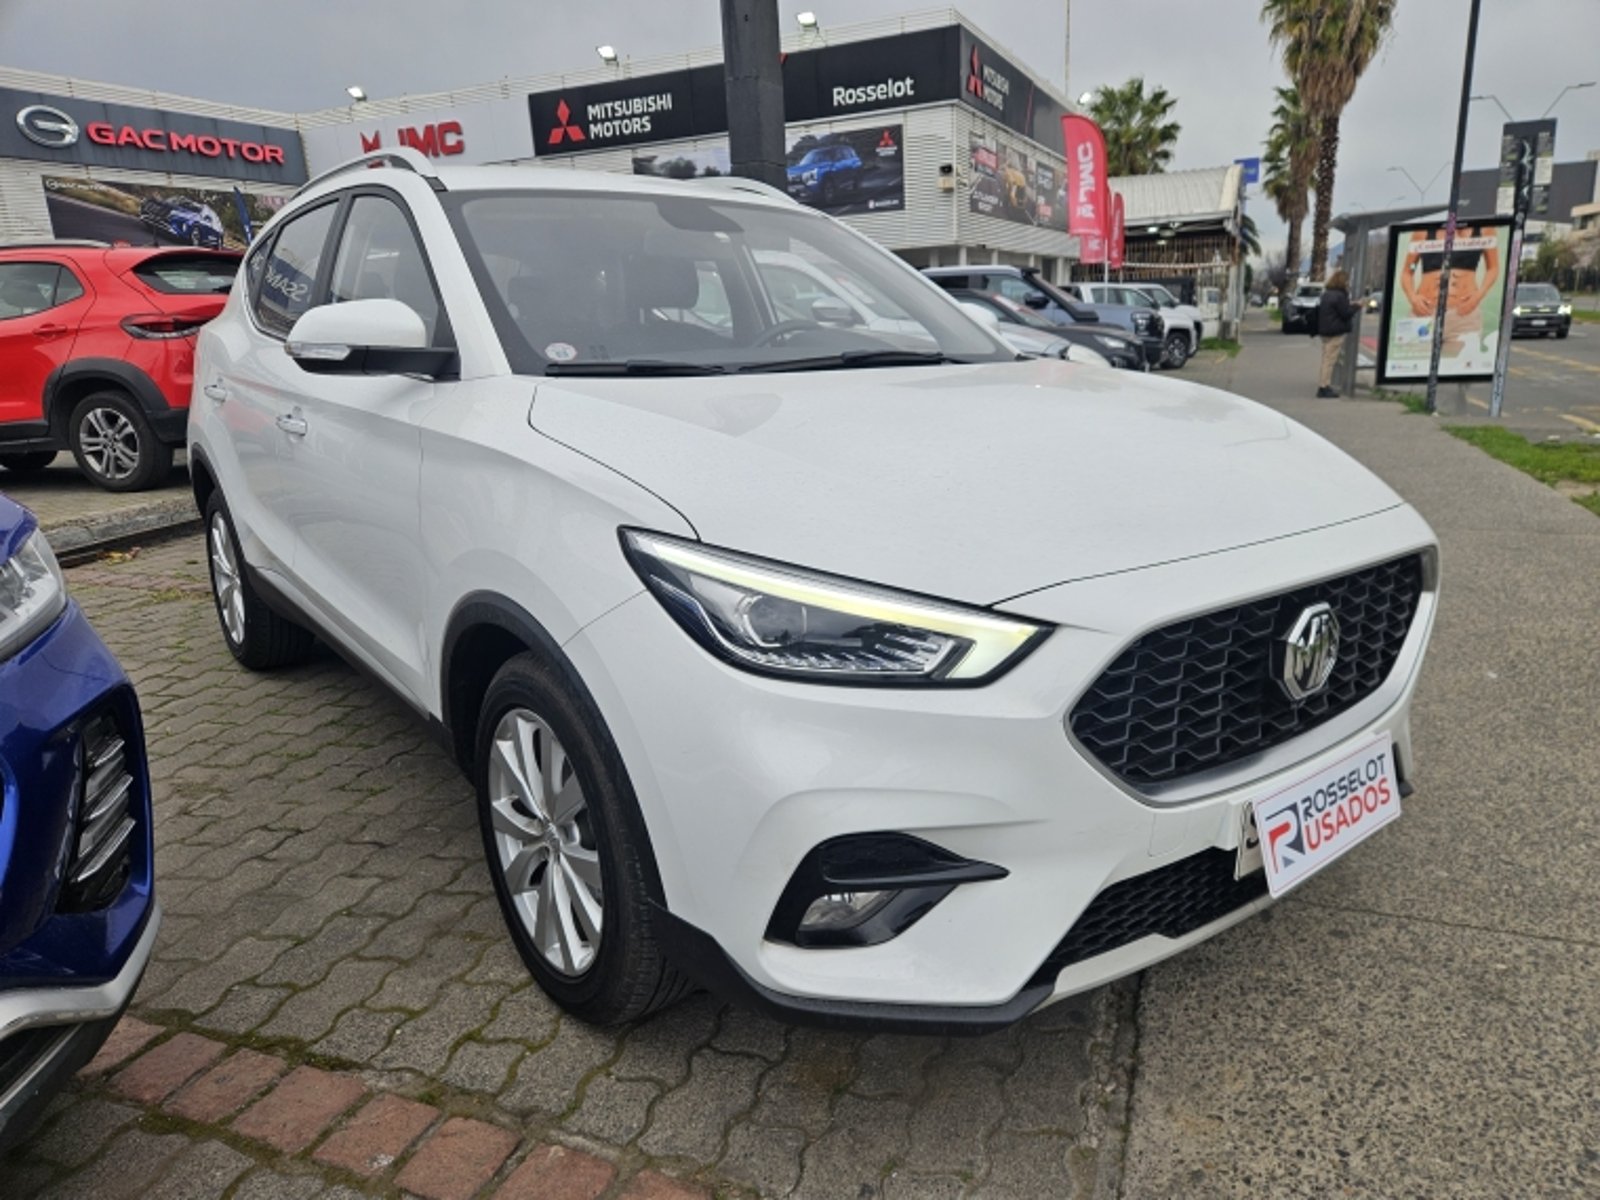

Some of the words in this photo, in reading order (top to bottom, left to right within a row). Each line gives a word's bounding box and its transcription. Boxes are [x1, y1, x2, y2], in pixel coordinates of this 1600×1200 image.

[586, 93, 673, 121] MITSUBISHI
[832, 76, 915, 107] Rosselot
[87, 121, 167, 150] GAC
[170, 133, 285, 165] MOTOR
[588, 115, 652, 140] MOTORS
[1302, 753, 1386, 822] ROSSELOT
[1304, 777, 1391, 851] USADOS
